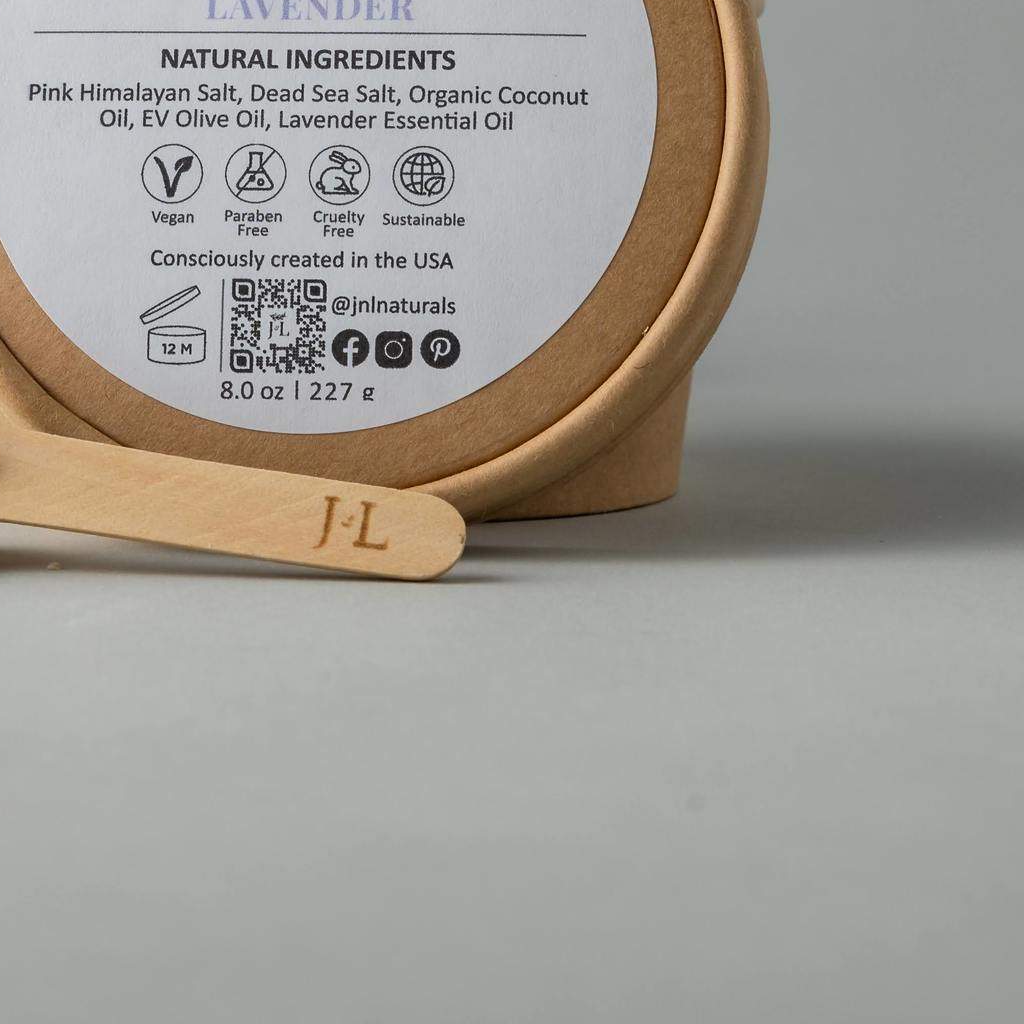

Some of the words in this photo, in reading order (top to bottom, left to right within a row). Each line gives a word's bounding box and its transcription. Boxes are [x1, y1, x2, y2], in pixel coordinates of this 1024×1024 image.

[161, 48, 278, 69] NATURAL
[287, 49, 455, 70] INGREDIENTS
[29, 83, 73, 101] Pink
[81, 82, 190, 106] Himalayan
[198, 83, 242, 105] Salt,
[251, 84, 304, 102] Dead
[312, 85, 348, 102] Sea
[356, 84, 401, 106] Salt,
[409, 85, 491, 109] Organic
[499, 87, 588, 105] Coconut
[100, 108, 134, 130] Oil,
[143, 110, 169, 127] EV
[176, 109, 229, 128] Olive
[236, 109, 270, 131] Oil,
[280, 110, 377, 129] Lavender
[384, 111, 476, 130] Essential
[485, 111, 512, 130] Oil
[152, 211, 194, 226] Vegan
[225, 209, 282, 223] Paraben
[314, 211, 365, 227] Cruelty
[383, 213, 465, 226] Sustainable
[238, 224, 268, 236] Free
[324, 225, 354, 237] Free
[151, 250, 265, 271] Consciously
[271, 251, 344, 268] created
[352, 252, 367, 268] in
[375, 251, 407, 269] the
[414, 252, 453, 269] USA
[332, 296, 455, 317] @jnlnaturals
[162, 343, 176, 355] 12
[181, 343, 192, 355] M
[221, 381, 254, 399] 8.0
[261, 386, 283, 400] oz
[310, 382, 352, 401] 227
[363, 387, 375, 401] g
